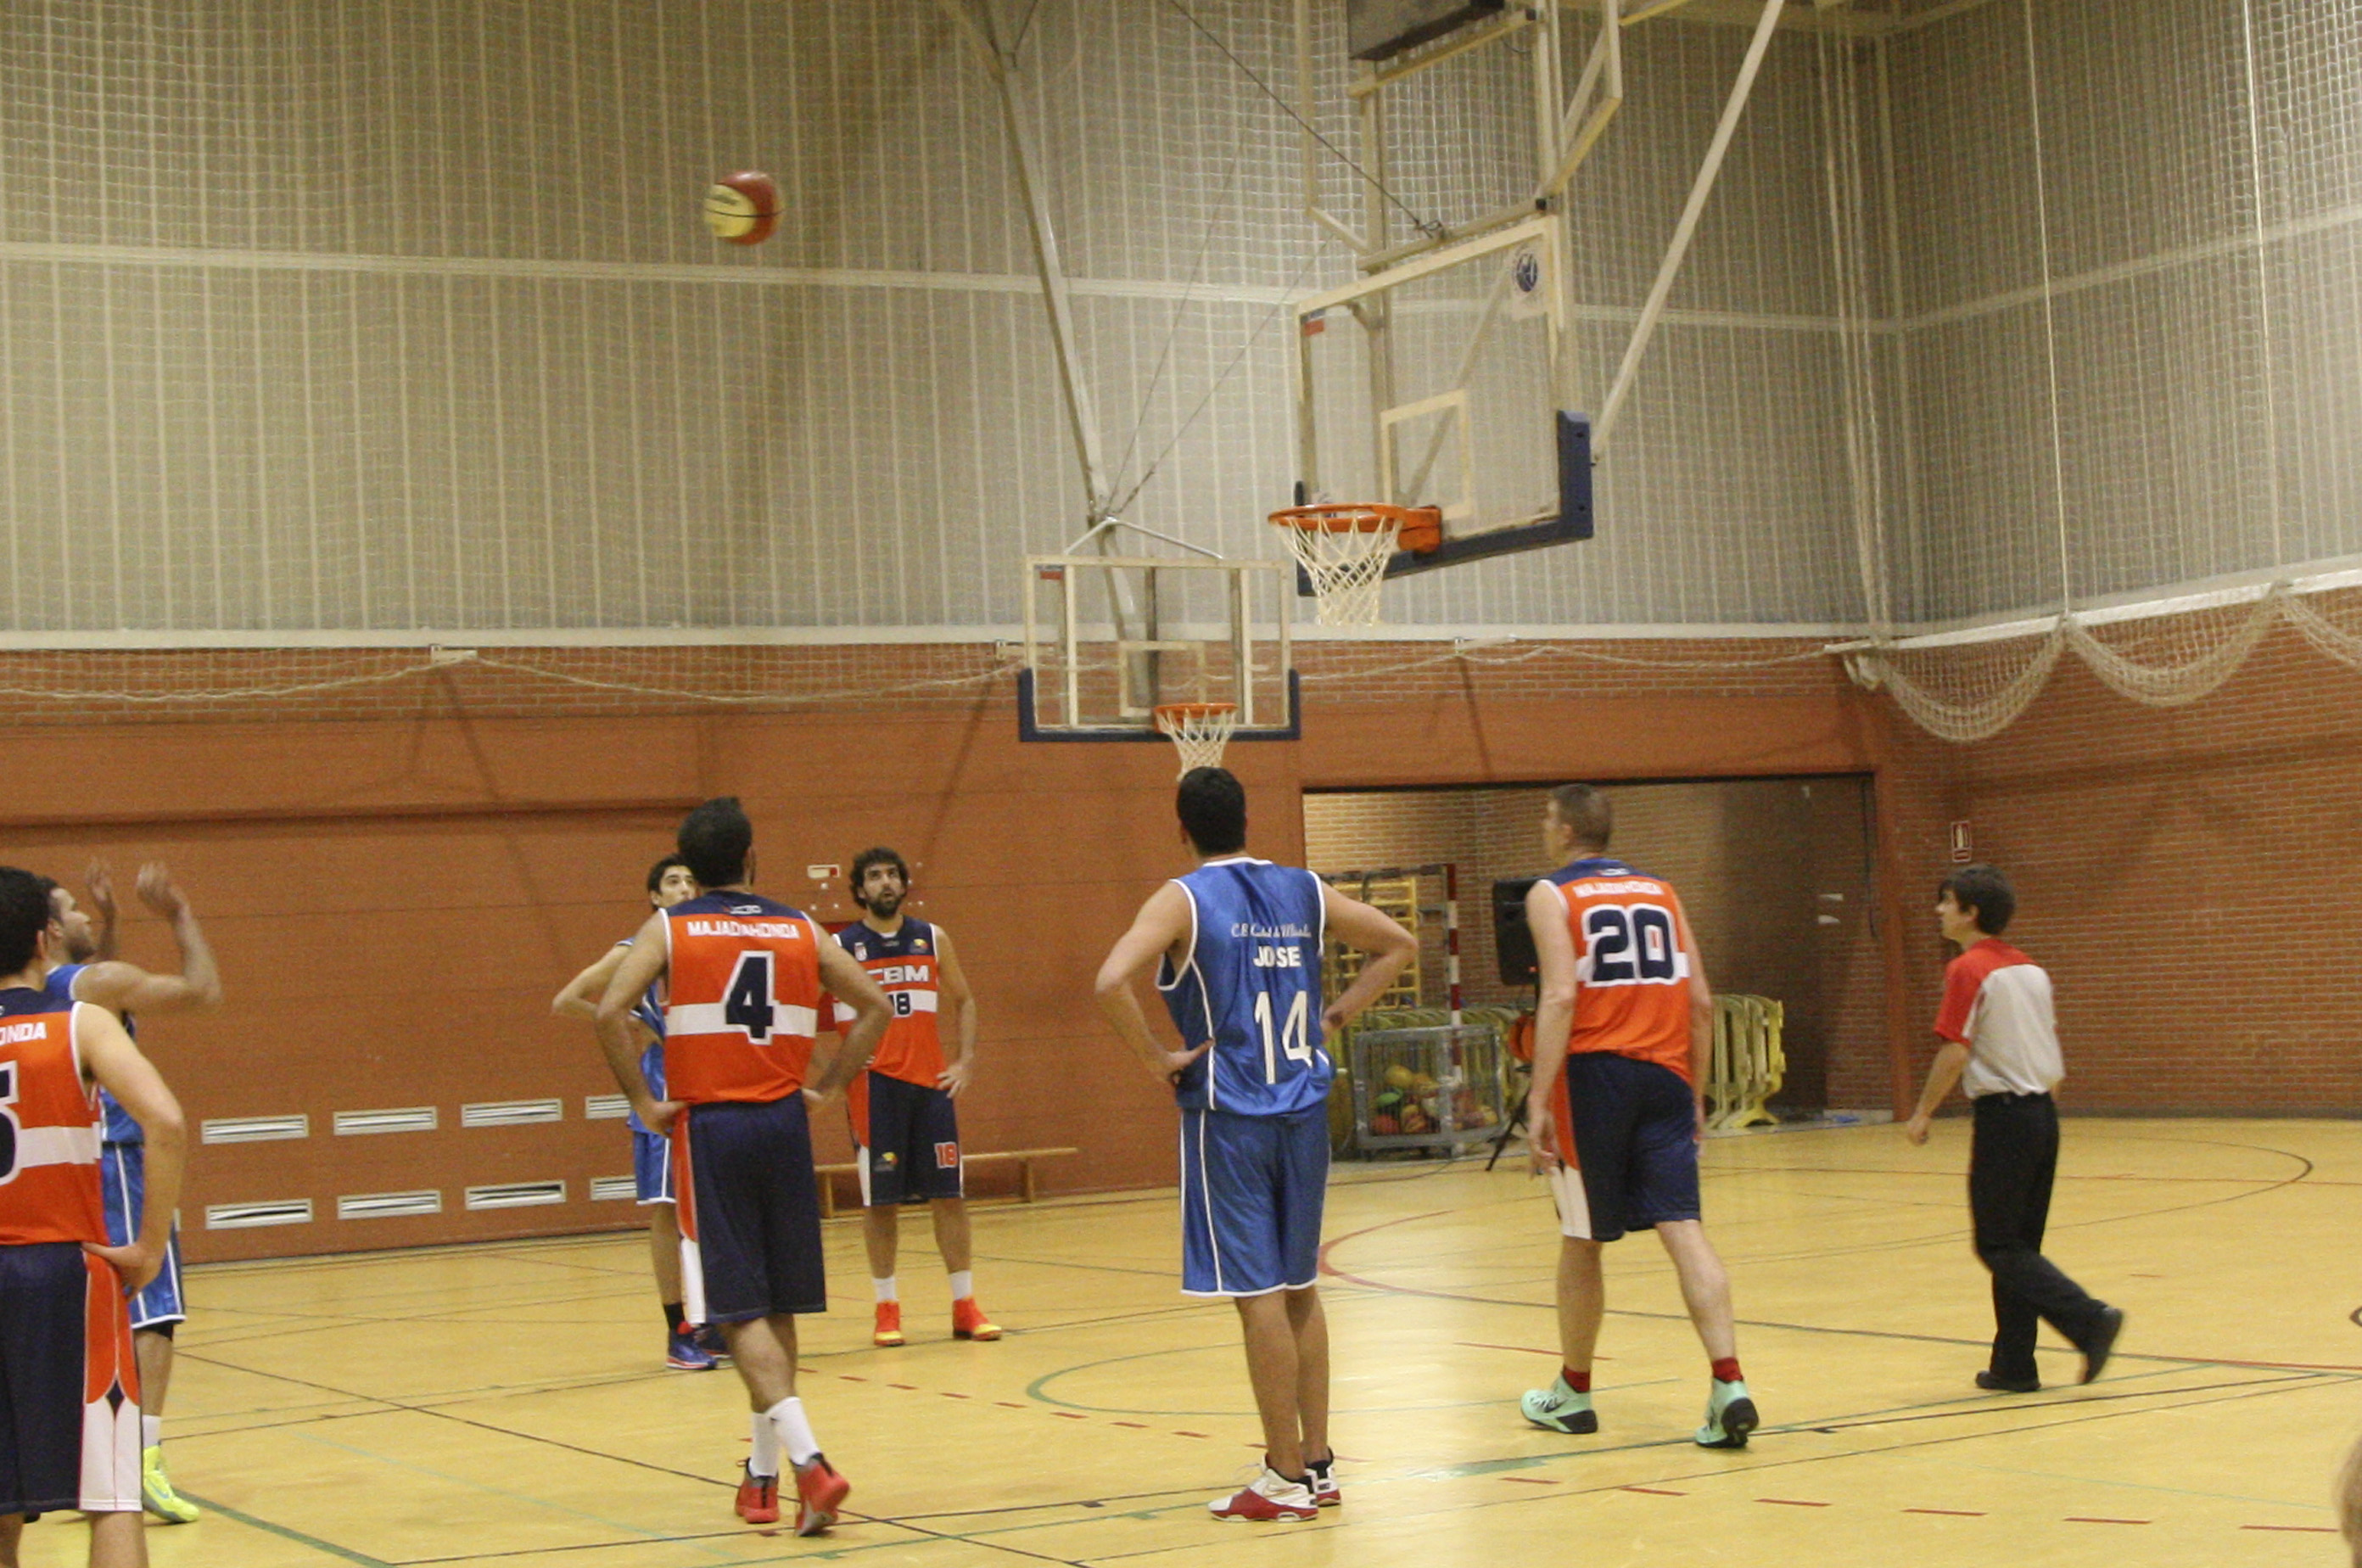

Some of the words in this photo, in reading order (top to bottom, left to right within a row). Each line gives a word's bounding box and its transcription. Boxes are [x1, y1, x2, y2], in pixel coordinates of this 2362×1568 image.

[1253, 945, 1301, 967] JOSE
[1581, 903, 1677, 987] 20
[720, 950, 775, 1044] 4
[1255, 990, 1313, 1084] 14
[934, 1141, 958, 1168] 18
